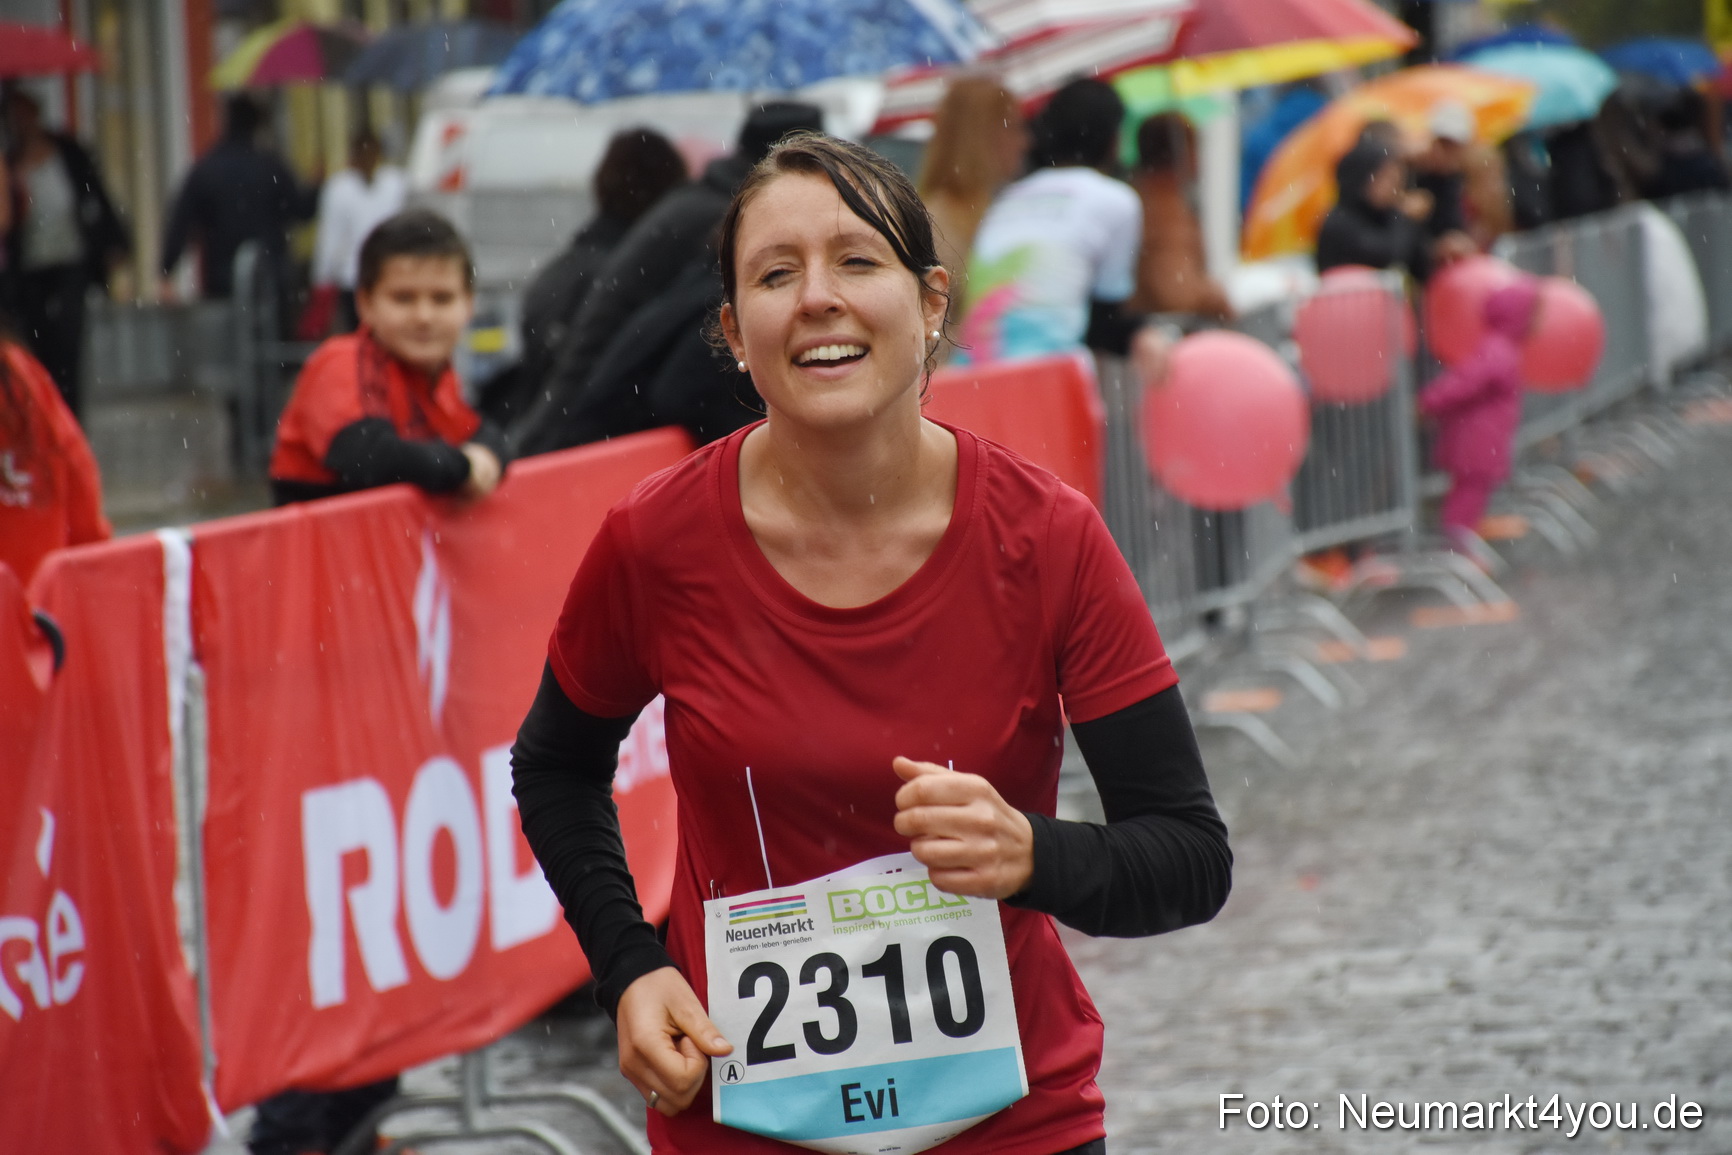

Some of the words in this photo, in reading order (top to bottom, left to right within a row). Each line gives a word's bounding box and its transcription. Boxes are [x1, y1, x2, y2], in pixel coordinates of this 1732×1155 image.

[827, 879, 969, 922] BOCK
[725, 918, 815, 943] NeuerMarkt
[833, 920, 875, 935] inspired
[878, 920, 891, 930] by
[894, 917, 922, 927] smart
[924, 908, 972, 923] concepts
[737, 935, 986, 1066] 2310
[726, 1064, 739, 1081] A
[841, 1078, 900, 1124] Evi
